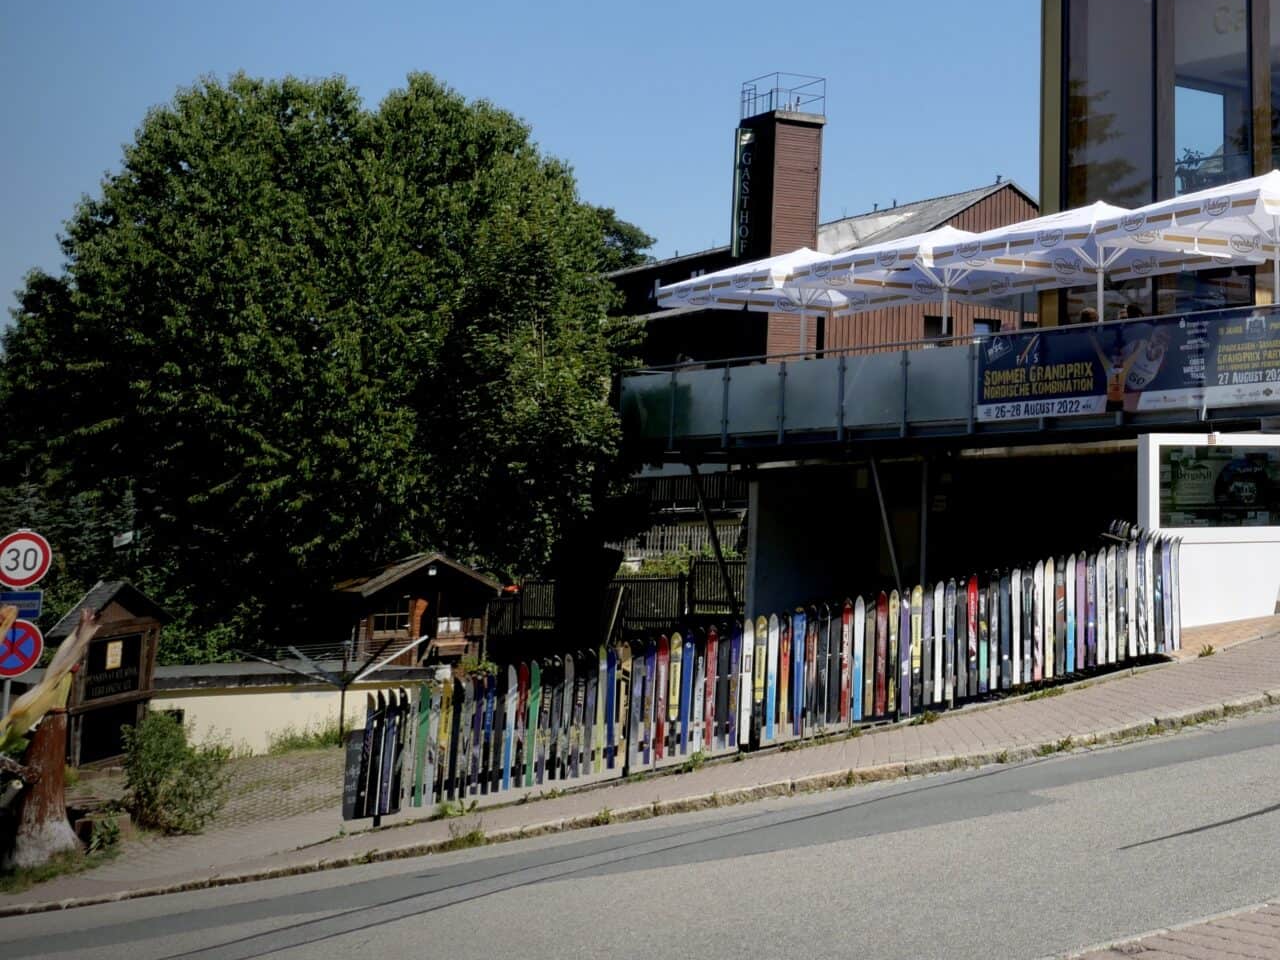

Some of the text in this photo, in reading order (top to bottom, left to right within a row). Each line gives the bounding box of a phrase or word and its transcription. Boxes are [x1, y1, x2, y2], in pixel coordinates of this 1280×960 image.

[738, 152, 752, 254] GASTHOF
[984, 362, 1093, 386] SOMMER GRANDPRIX
[1218, 372, 1229, 385] 27
[1232, 370, 1263, 384] AUGUST
[984, 378, 1094, 400] NORDISCHE KOMBINATION
[1024, 401, 1055, 417] AUGUST
[1057, 399, 1080, 413] 2022
[5, 548, 38, 571] 30
